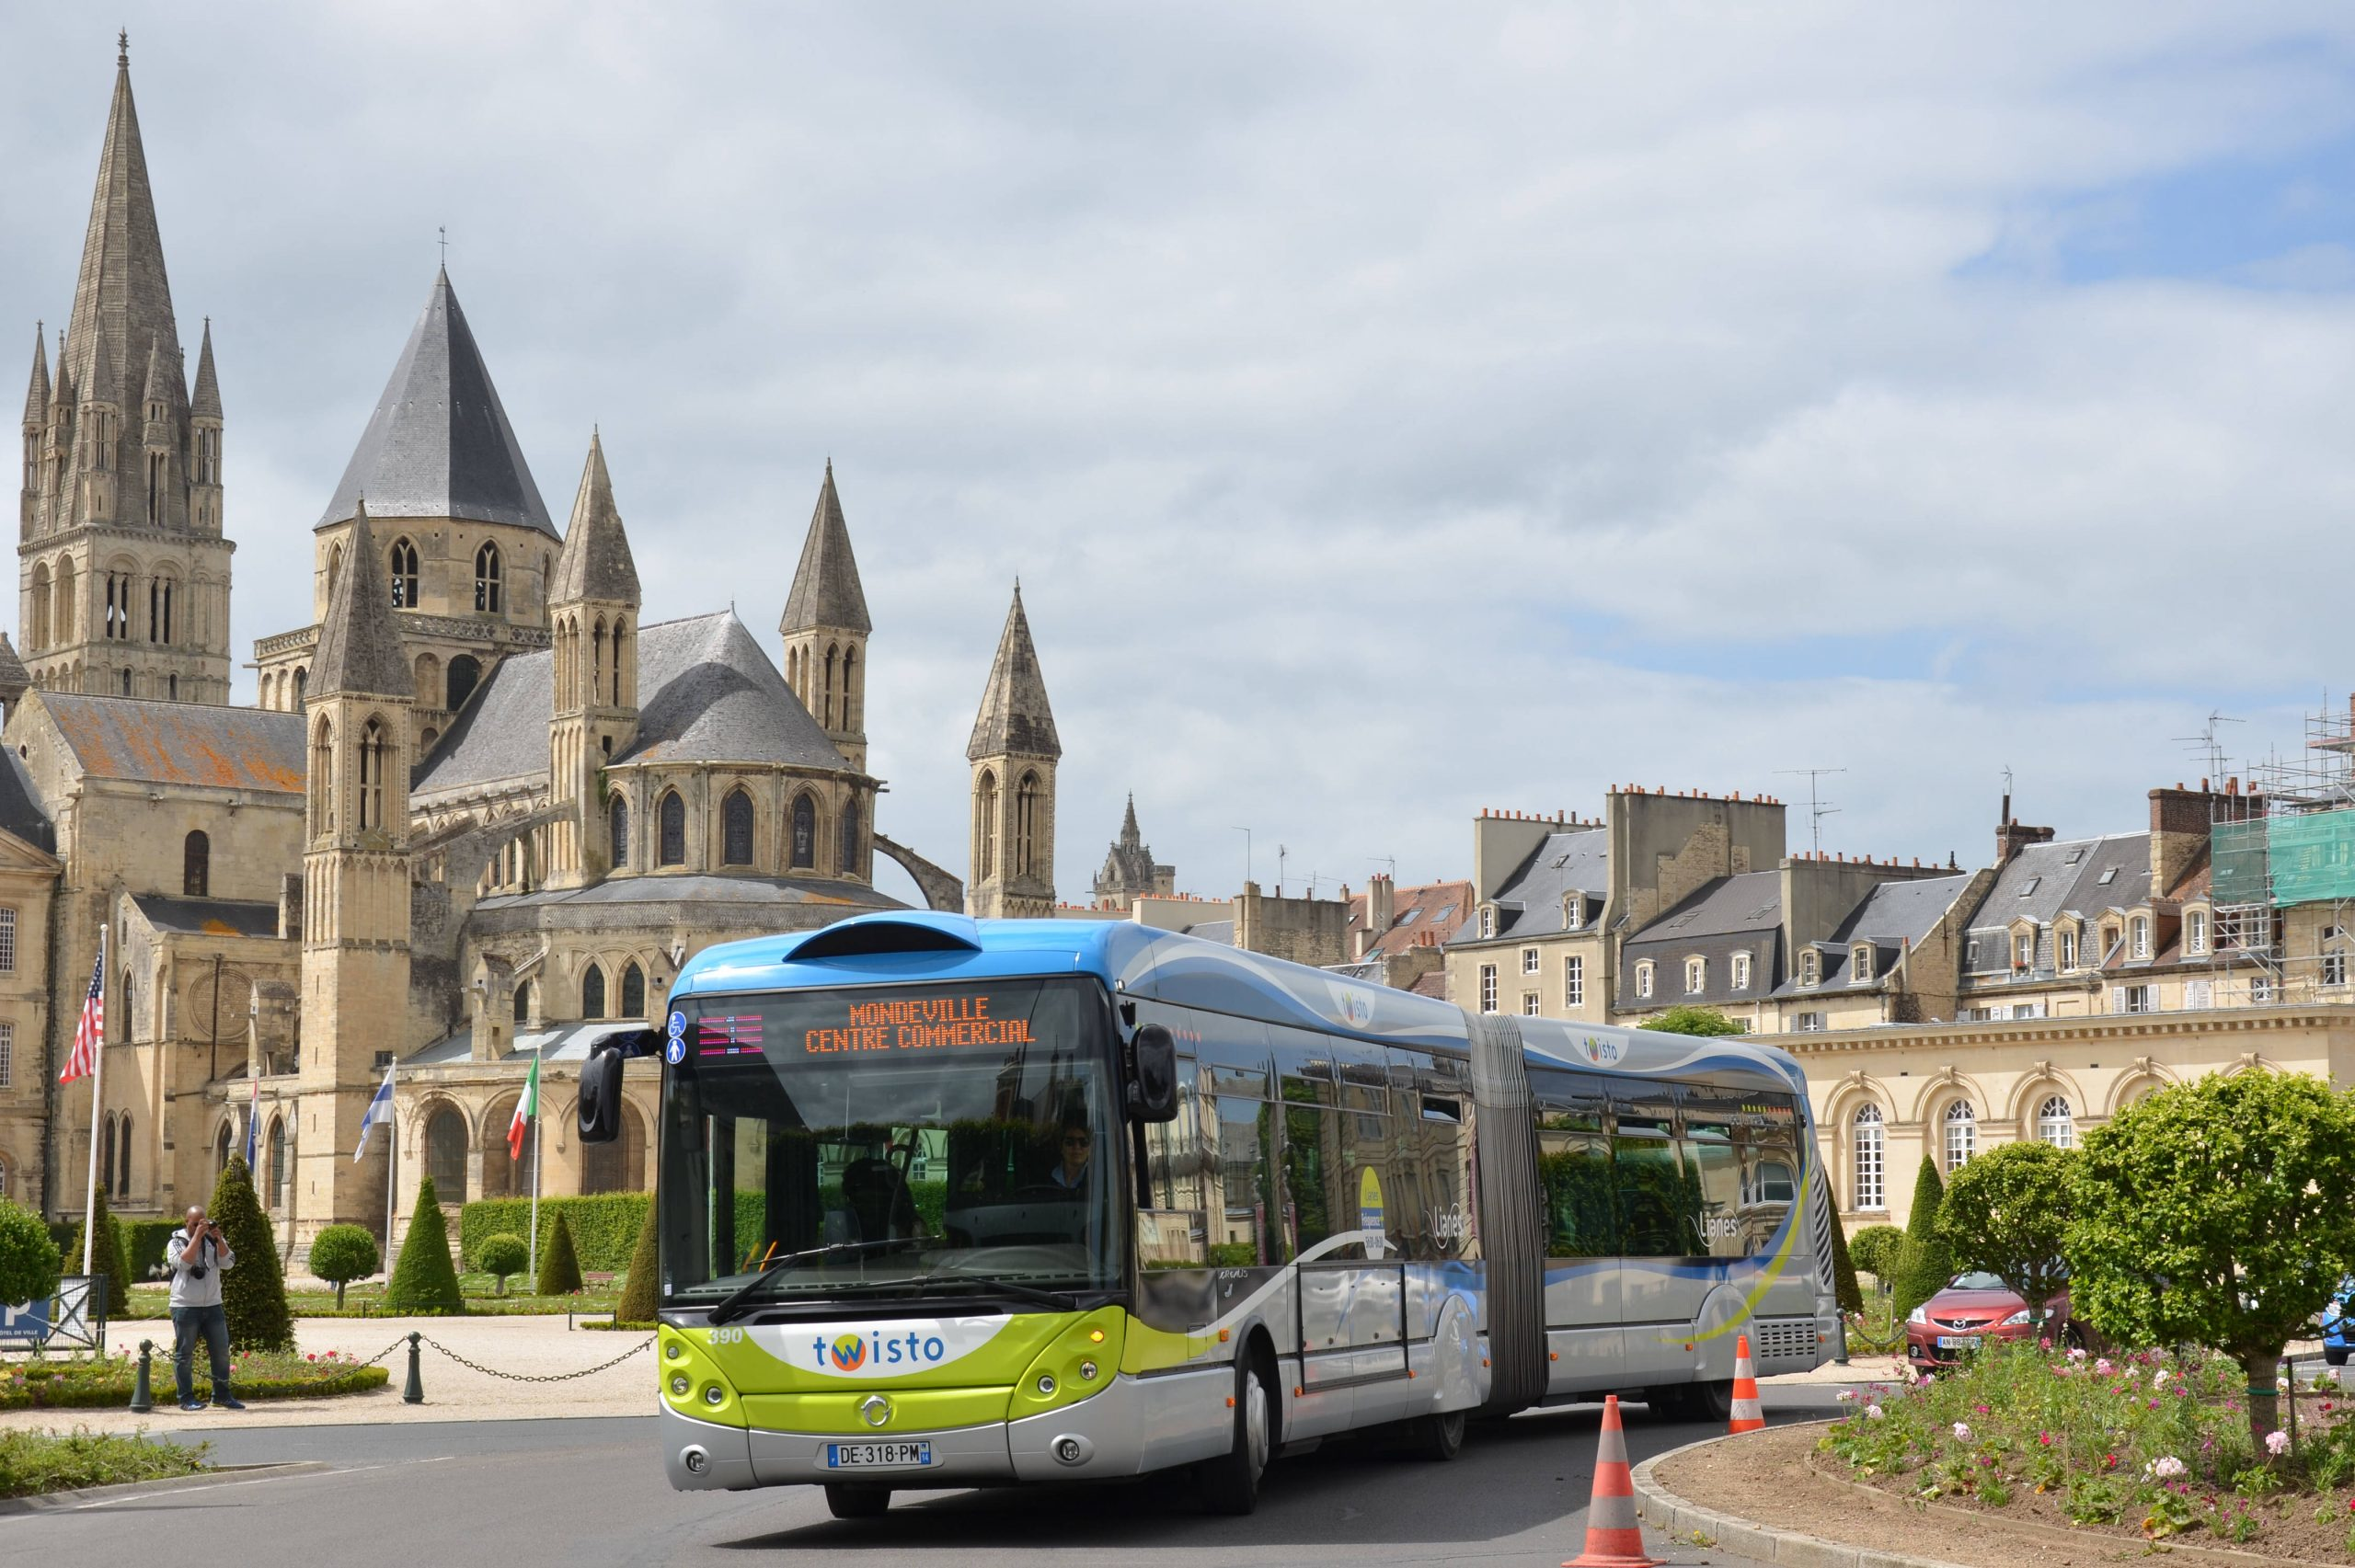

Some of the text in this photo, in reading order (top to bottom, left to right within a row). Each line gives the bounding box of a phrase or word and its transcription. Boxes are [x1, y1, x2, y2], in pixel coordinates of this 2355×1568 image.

[849, 997, 989, 1026] MONDEVILLE
[806, 1019, 1036, 1052] CENTRE COMMERCIAL
[1430, 1204, 1464, 1242] Lianes
[1694, 1208, 1740, 1242] Lianes
[707, 1327, 743, 1344] 390
[813, 1331, 944, 1369] twisto
[840, 1445, 919, 1463] DE-318-PM
